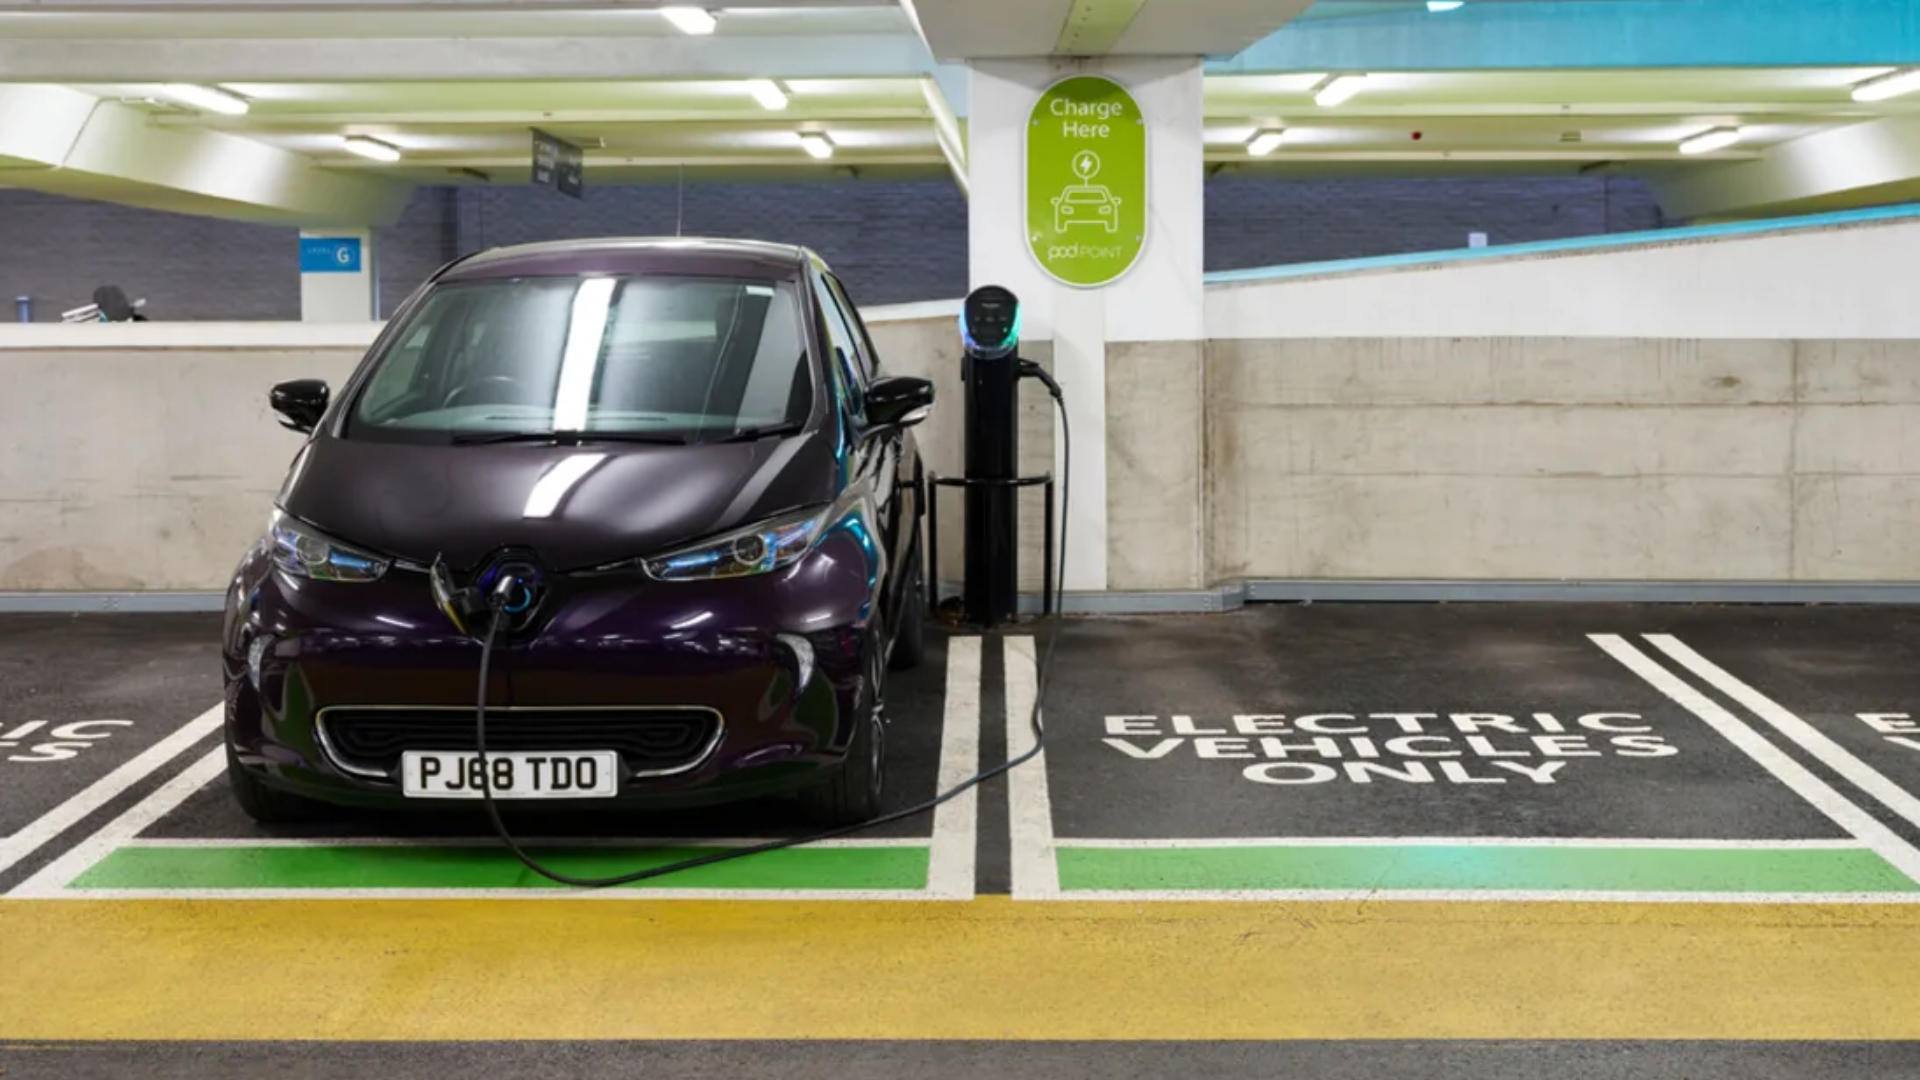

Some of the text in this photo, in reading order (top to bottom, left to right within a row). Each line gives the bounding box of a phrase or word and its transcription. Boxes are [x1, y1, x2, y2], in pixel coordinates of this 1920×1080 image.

[1050, 98, 1123, 119] Charge
[1062, 122, 1110, 138] Here
[336, 247, 351, 264] G
[0, 720, 135, 739] IC
[1104, 713, 1653, 734] ELECTRIC
[1102, 735, 1679, 758] VEHICLES
[420, 757, 597, 790] PJ68 TDO
[1242, 761, 1567, 784] ONLY
